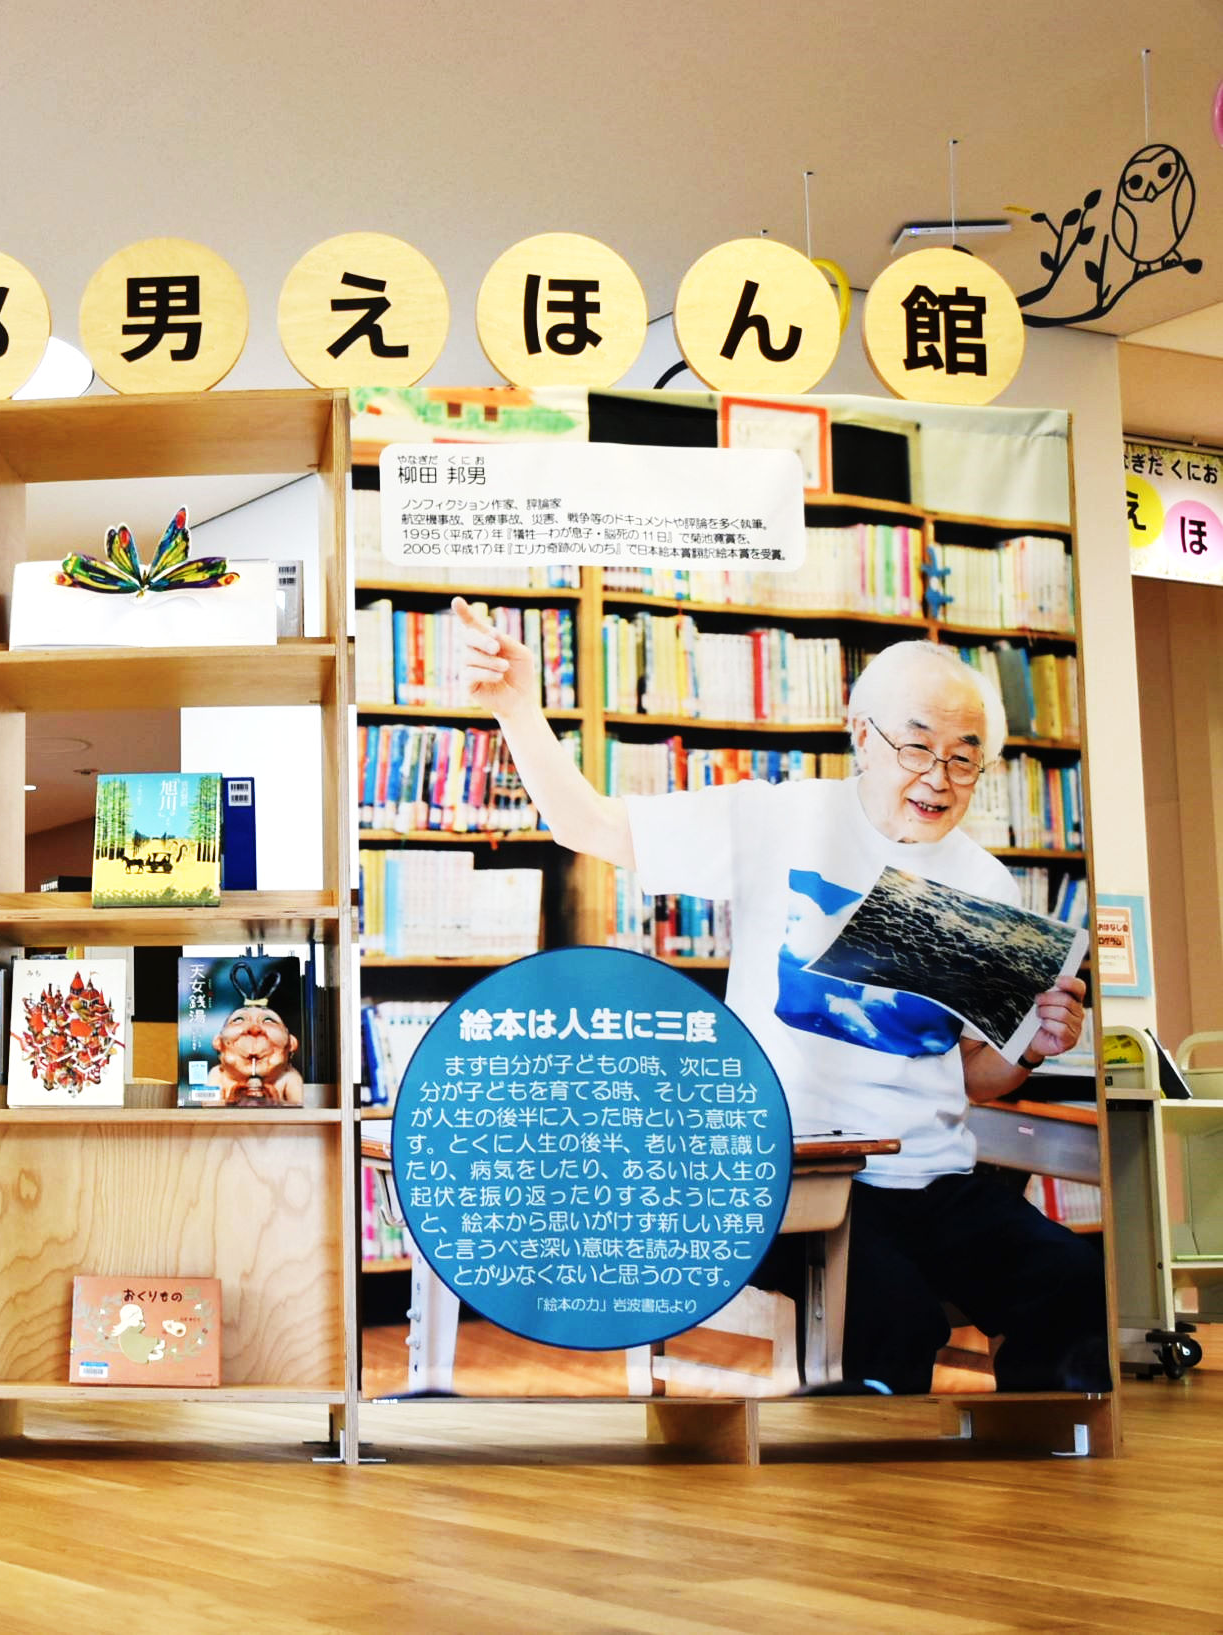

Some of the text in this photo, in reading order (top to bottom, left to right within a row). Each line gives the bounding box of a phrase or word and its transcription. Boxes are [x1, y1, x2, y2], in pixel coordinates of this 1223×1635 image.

[397, 455, 438, 465] やなぎだ
[1171, 459, 1218, 484] くにお
[397, 466, 486, 485] 柳田 邦男
[188, 964, 207, 1024] 天女銭湯
[459, 1008, 718, 1044] 絵本は人生に三度
[444, 1054, 742, 1078] まず自分が子どもの時、次に自
[419, 1080, 758, 1103] 分が子どもを育てる時、そして自分
[410, 1106, 768, 1129] が人生の後半に入った時という意味で
[406, 1133, 777, 1156] す。とくに人生の後半、老いを意識し
[405, 1159, 777, 1182] たり、病気をしたり、あるいは人生の
[409, 1185, 773, 1208] 起伏を振り返ったりするようになる
[420, 1211, 765, 1234] と、絵本から思いがけず新しい発見
[434, 1237, 753, 1260] と言うべき深い意味を読み取るこ
[453, 1264, 731, 1287] とが少なくないと思うのです。
[123, 1288, 183, 1303] おくりもの
[536, 1296, 697, 1314] 「絵本の力」岩波書店より
